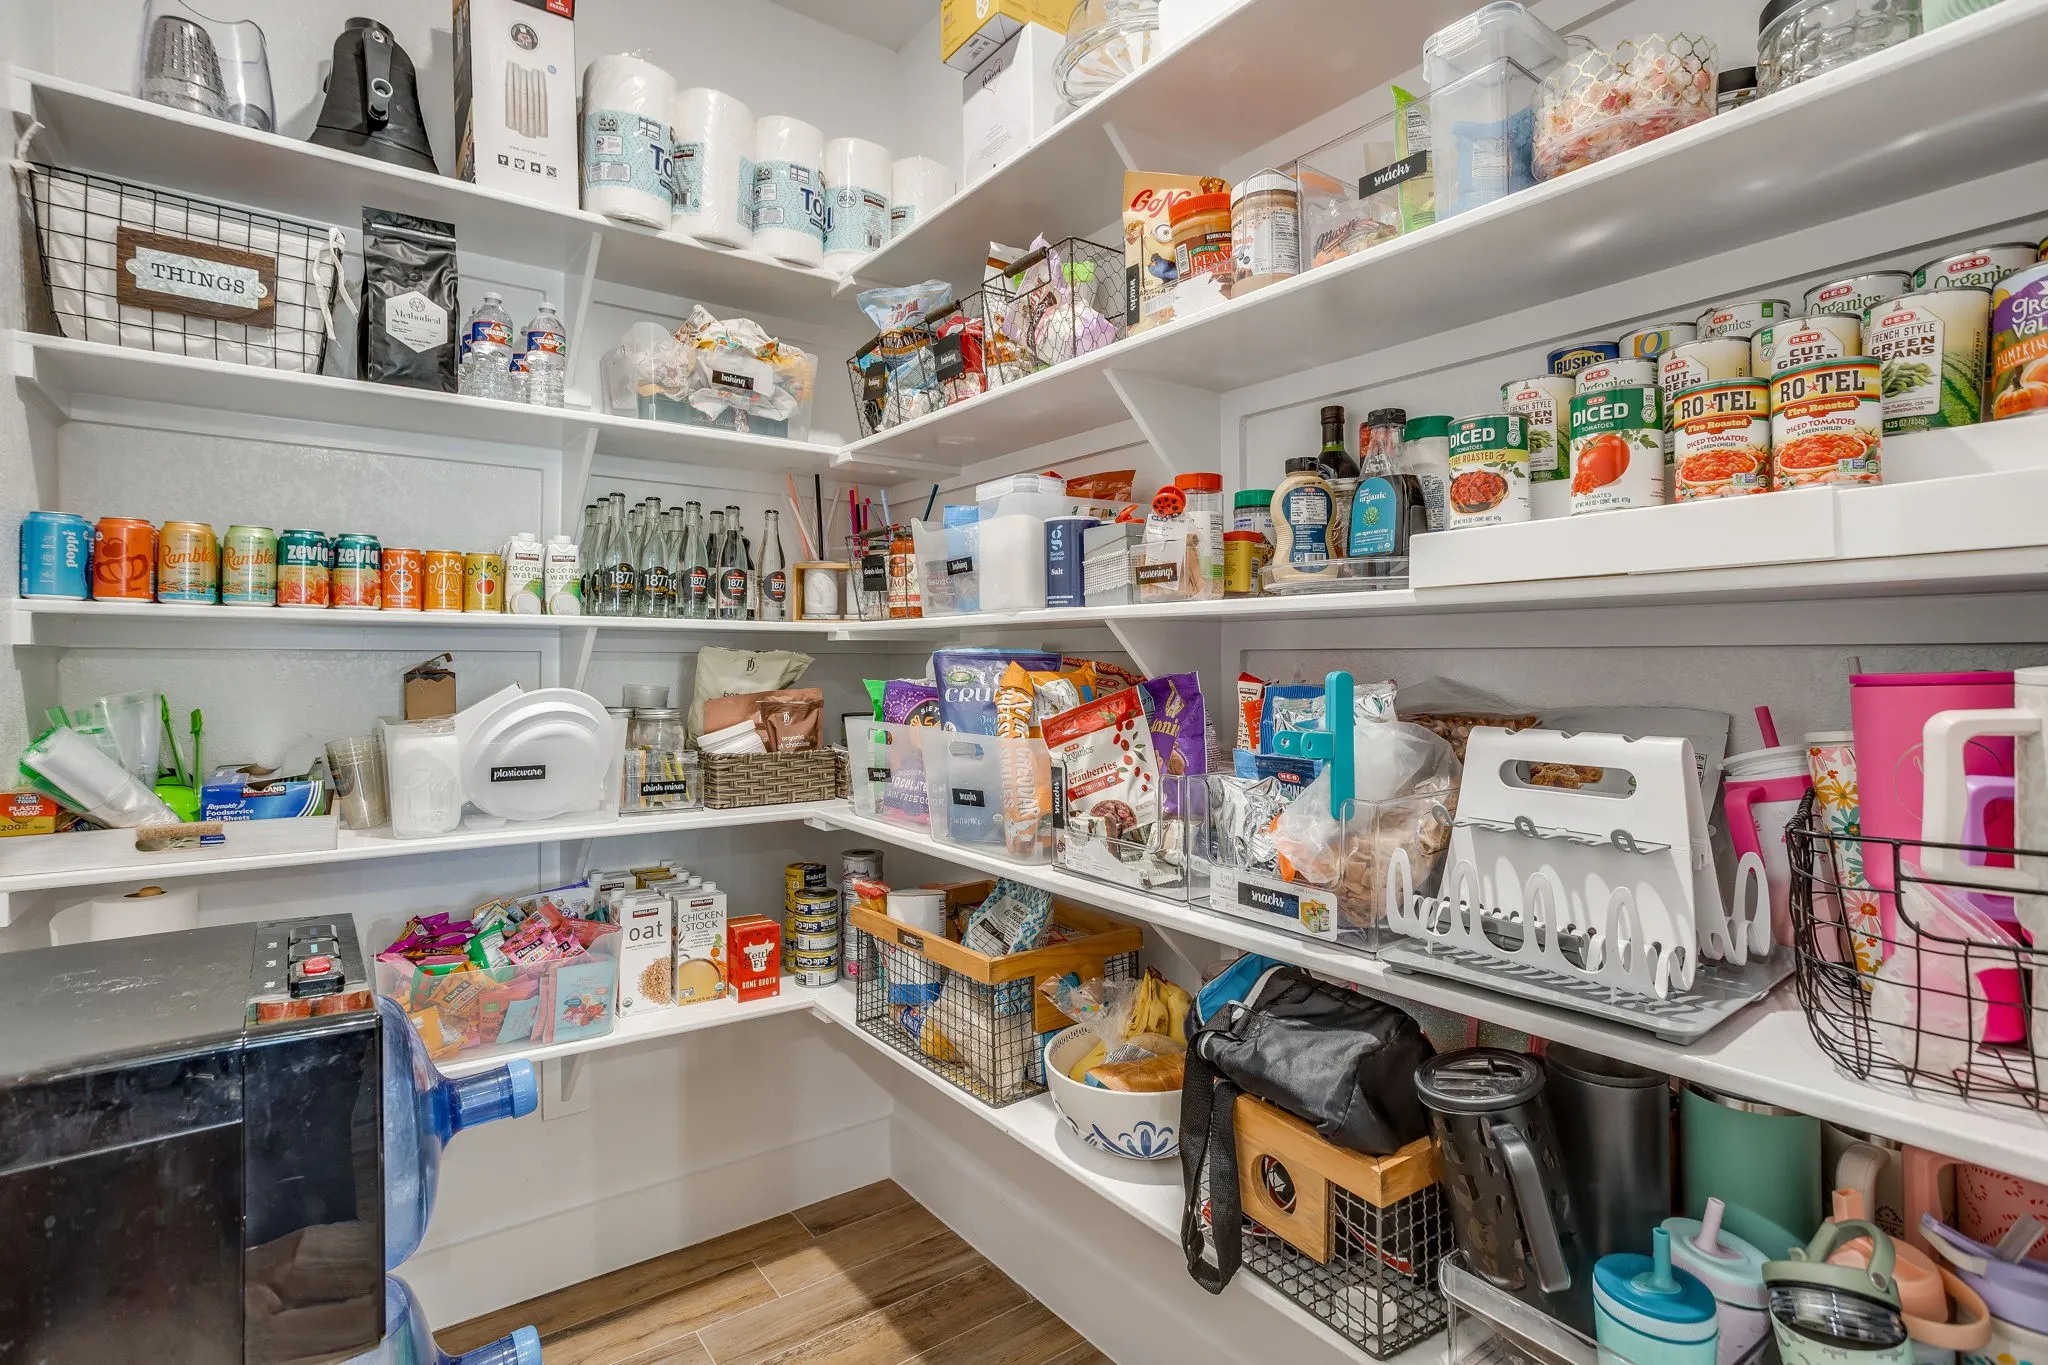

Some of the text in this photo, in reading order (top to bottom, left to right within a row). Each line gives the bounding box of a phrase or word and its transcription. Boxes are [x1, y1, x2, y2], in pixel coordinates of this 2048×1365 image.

[1373, 159, 1411, 187] snacks
[151, 261, 246, 295] THINGS
[1810, 294, 1881, 315] Organics
[394, 308, 442, 325] Methodical
[1704, 319, 1752, 338] Organics
[1871, 322, 1935, 345] FRENCH STYLE
[1790, 344, 1825, 358] CUT
[1871, 335, 1935, 356] GREEN
[1555, 353, 1605, 375] BUSH'S
[721, 372, 746, 388] baking
[1665, 371, 1689, 384] CUT
[1665, 377, 1701, 394] REEN
[1532, 401, 1552, 410] STYLE
[1787, 401, 1855, 417] Fire Roasted
[1529, 410, 1552, 418] EEN
[1573, 402, 1629, 428] DICED
[1529, 417, 1552, 426] ANS
[1581, 421, 1614, 432] TOMATOES
[1687, 418, 1748, 433] Fire Roasted
[1786, 418, 1856, 434] DICED TOMATOES
[1449, 427, 1496, 449] DICED
[1801, 427, 1820, 435] GREEN
[1686, 435, 1748, 450] DICED TOMATOES
[1462, 452, 1494, 463] ROASTED
[1360, 491, 1387, 504] organic
[62, 530, 80, 568] poppi
[610, 571, 634, 584] 1877
[1051, 567, 1064, 576] Salt
[1139, 566, 1173, 580] seasonings
[644, 574, 669, 586] 1877
[690, 576, 706, 586] 1877
[727, 578, 744, 587] 1877
[771, 581, 785, 590] 1877
[945, 687, 996, 703] CRU
[921, 705, 941, 715] SIET
[1061, 745, 1094, 763] Organics
[493, 767, 543, 779] plasticware
[1069, 761, 1118, 785] cranberries
[242, 785, 285, 794] KILAND
[643, 783, 685, 792] drink mixes
[891, 775, 929, 793] OCOLATE
[900, 793, 918, 803] FREE
[1251, 888, 1285, 909] snacks
[681, 910, 724, 923] CHICKEN
[629, 920, 663, 941] oat
[686, 920, 719, 932] STOCK
[744, 948, 774, 960] Kettle
[753, 959, 774, 968] Fire
[742, 977, 776, 990] BONE BROTH
